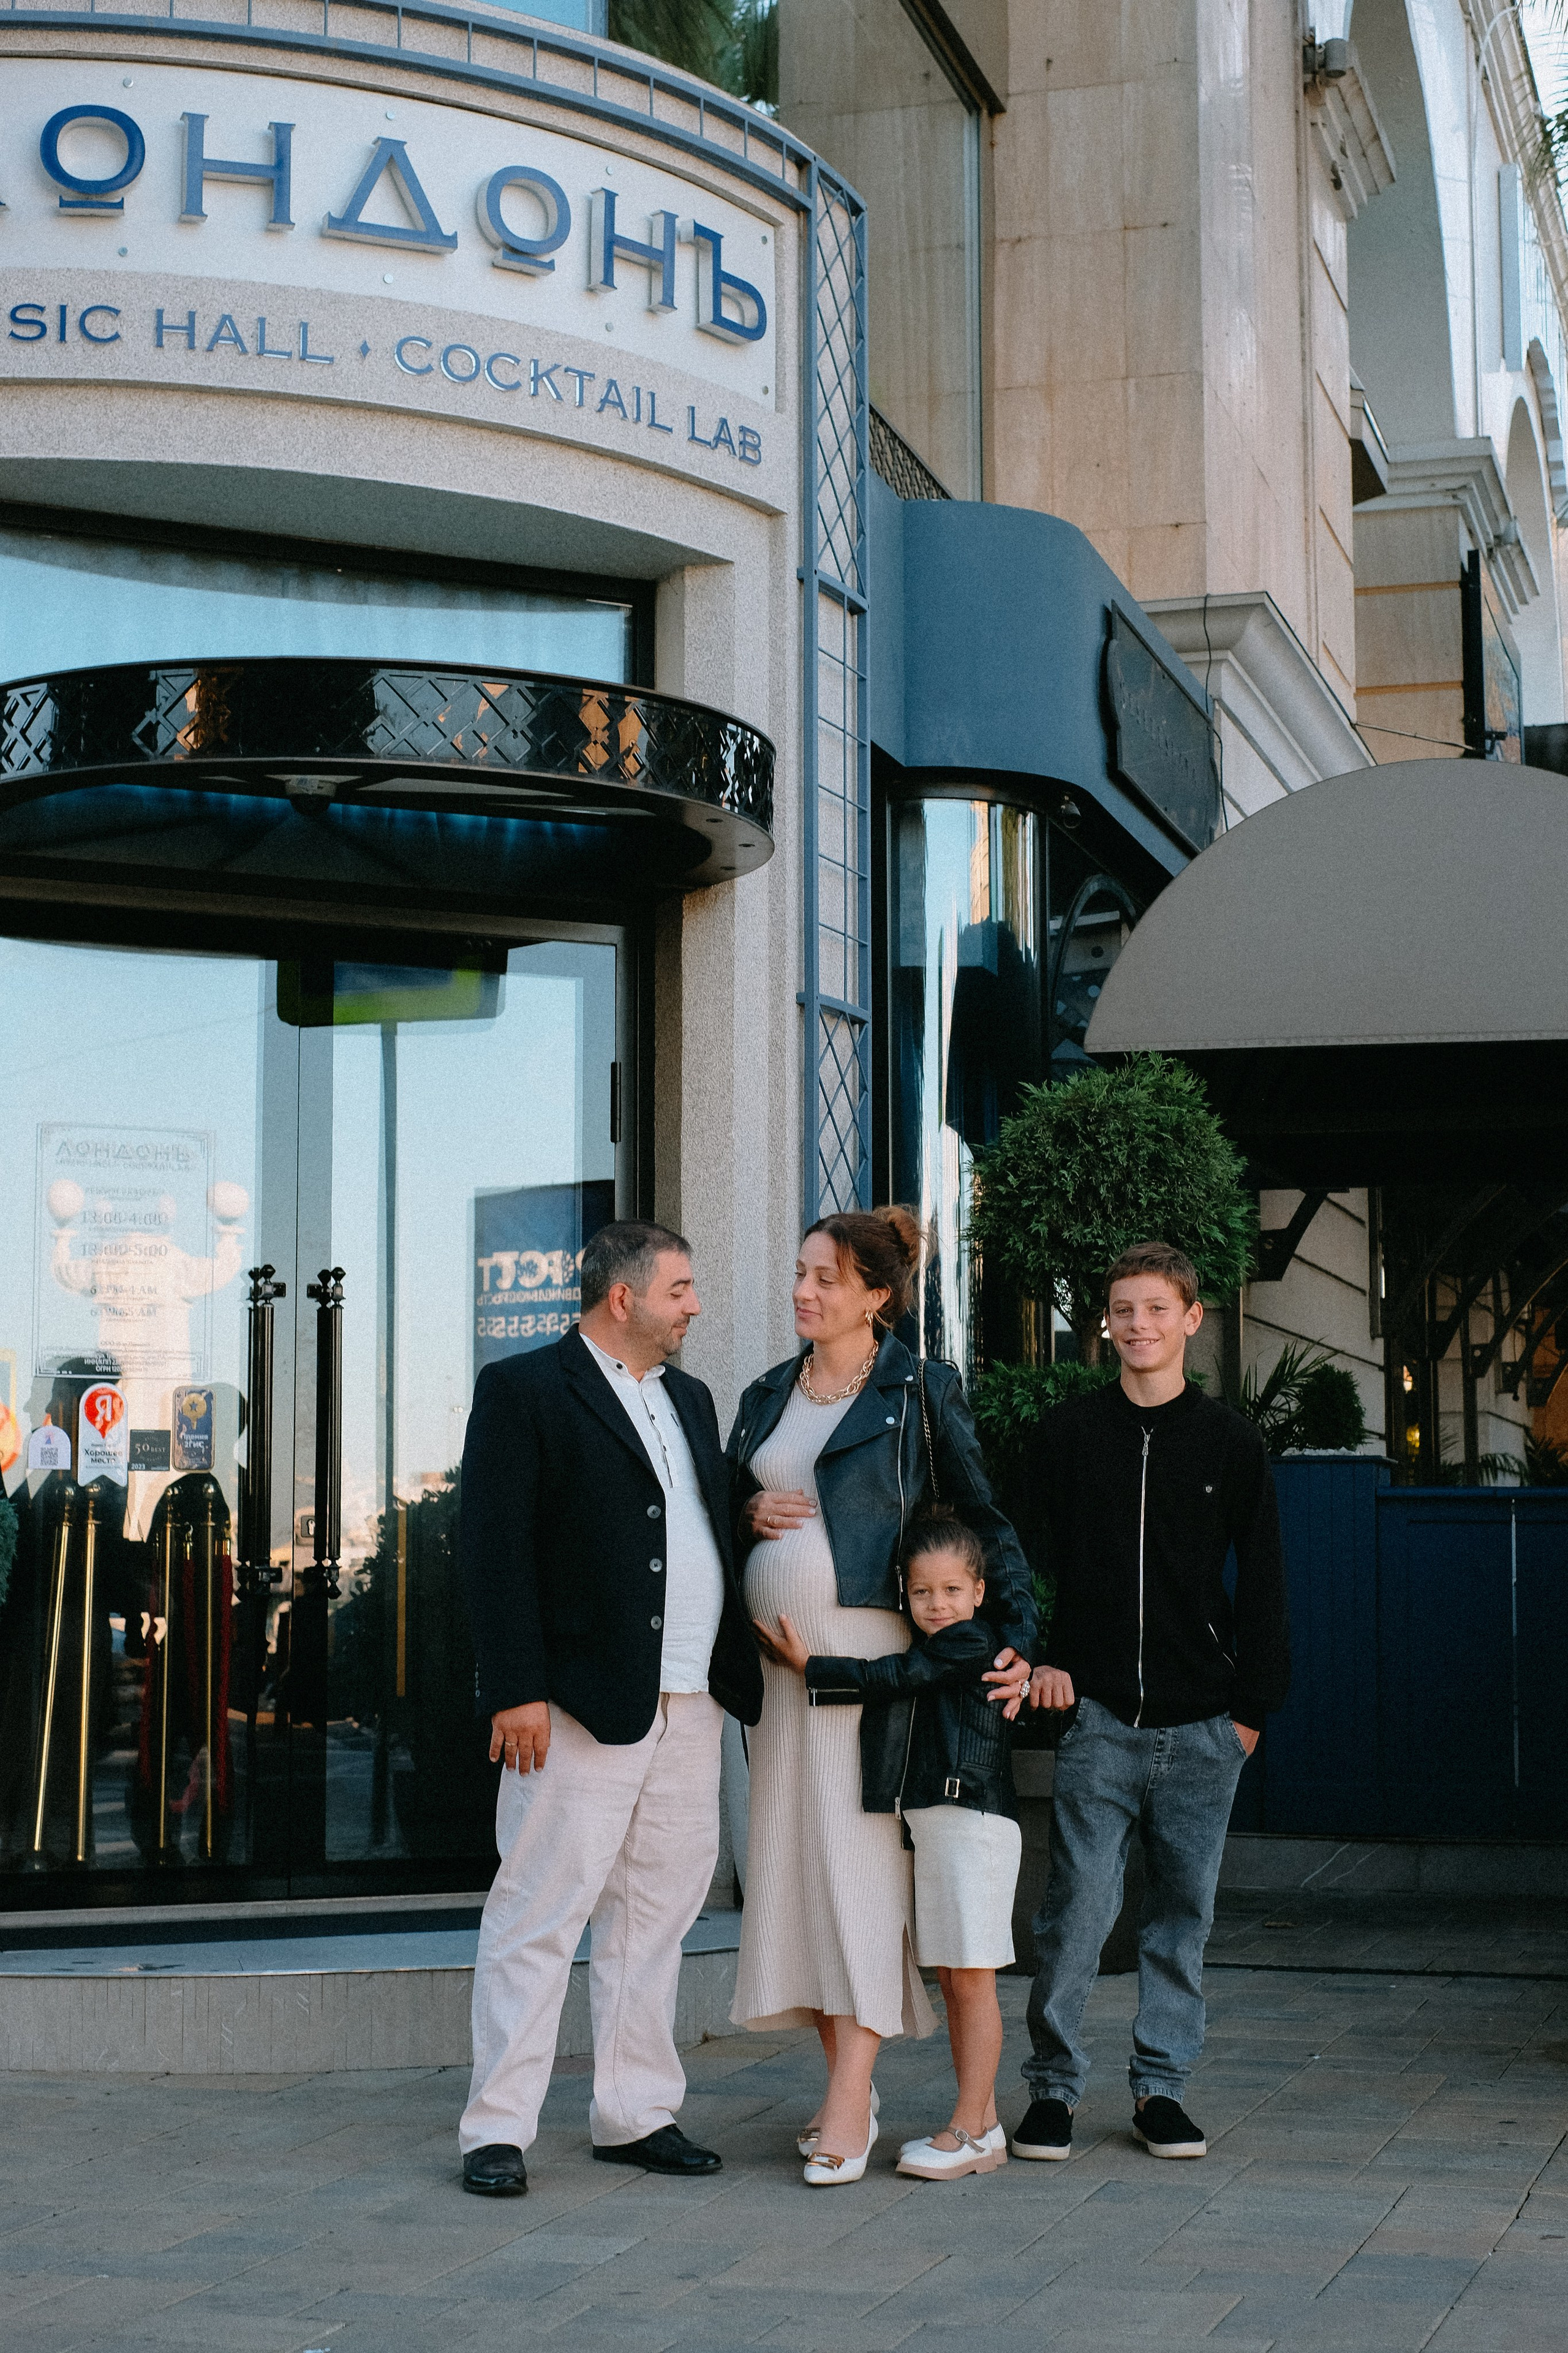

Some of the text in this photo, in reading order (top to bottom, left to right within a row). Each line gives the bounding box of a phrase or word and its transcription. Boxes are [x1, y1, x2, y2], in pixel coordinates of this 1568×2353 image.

[0, 104, 767, 344] ОНДОНЪ
[7, 303, 763, 466] SIC HALL COCKTAIL LAB
[95, 1394, 111, 1422] Я
[84, 1448, 123, 1457] Хорошее
[135, 1443, 149, 1455] 50
